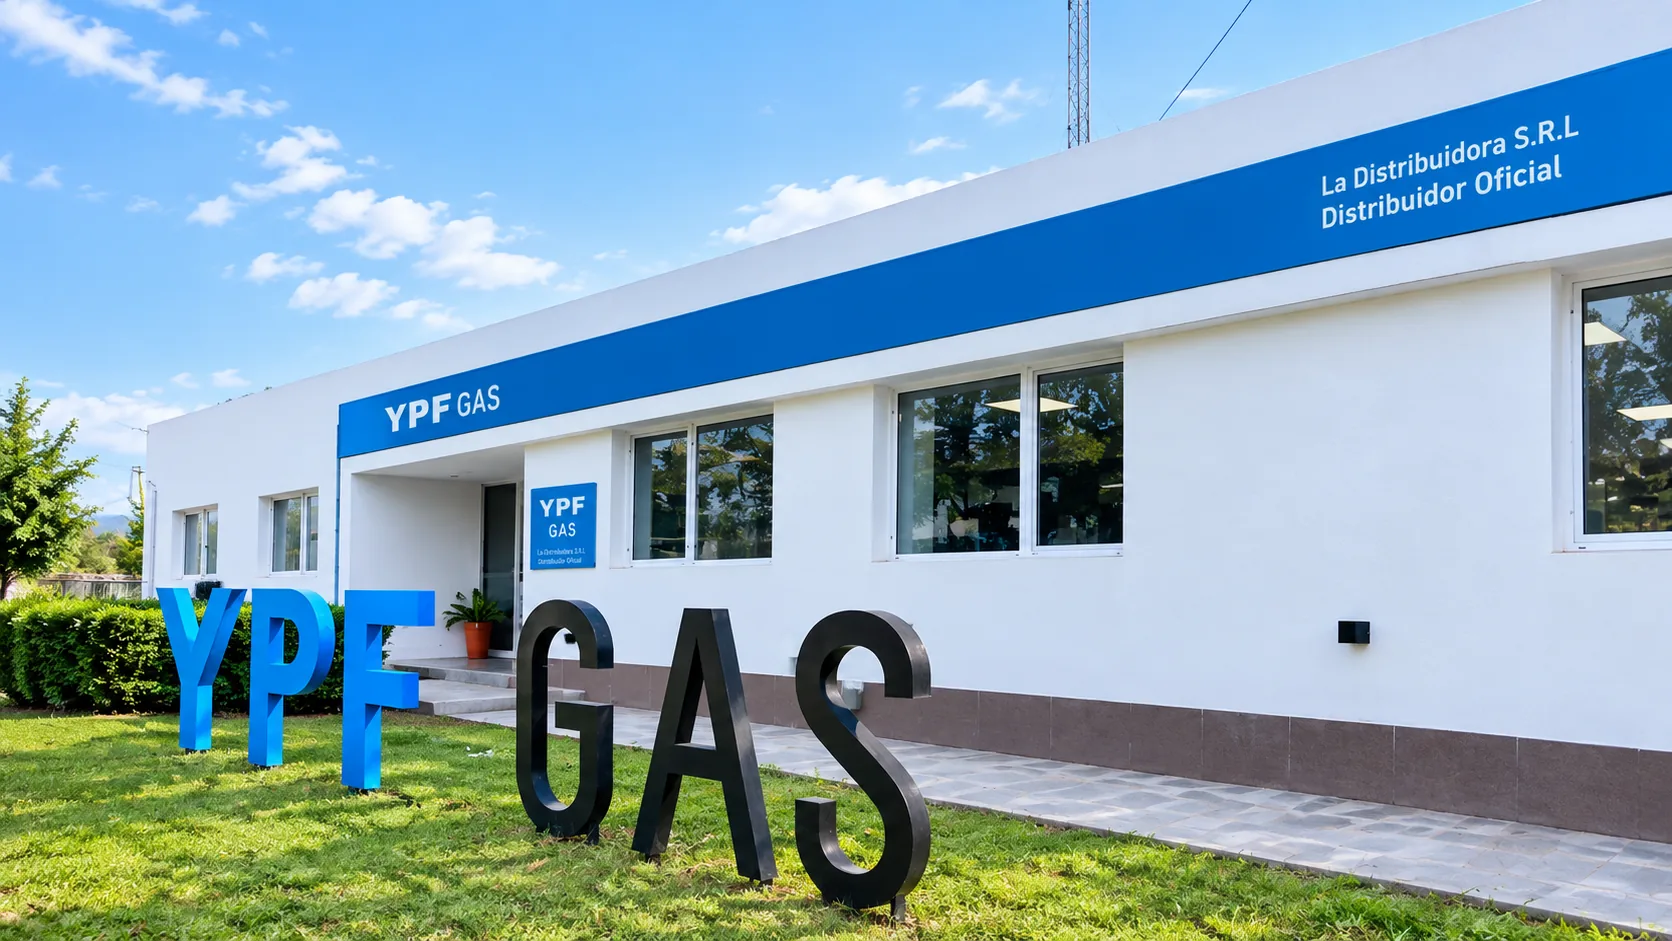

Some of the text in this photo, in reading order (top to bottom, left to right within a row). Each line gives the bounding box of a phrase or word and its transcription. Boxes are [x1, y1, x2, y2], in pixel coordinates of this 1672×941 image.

[1321, 114, 1580, 197] La Distribuidora S.R.L
[1321, 154, 1562, 230] Distribuidor Oficial
[384, 384, 500, 432] YPF GAS
[539, 495, 586, 518] YPF
[548, 522, 576, 538] GAS
[156, 587, 932, 911] YPF GAS
